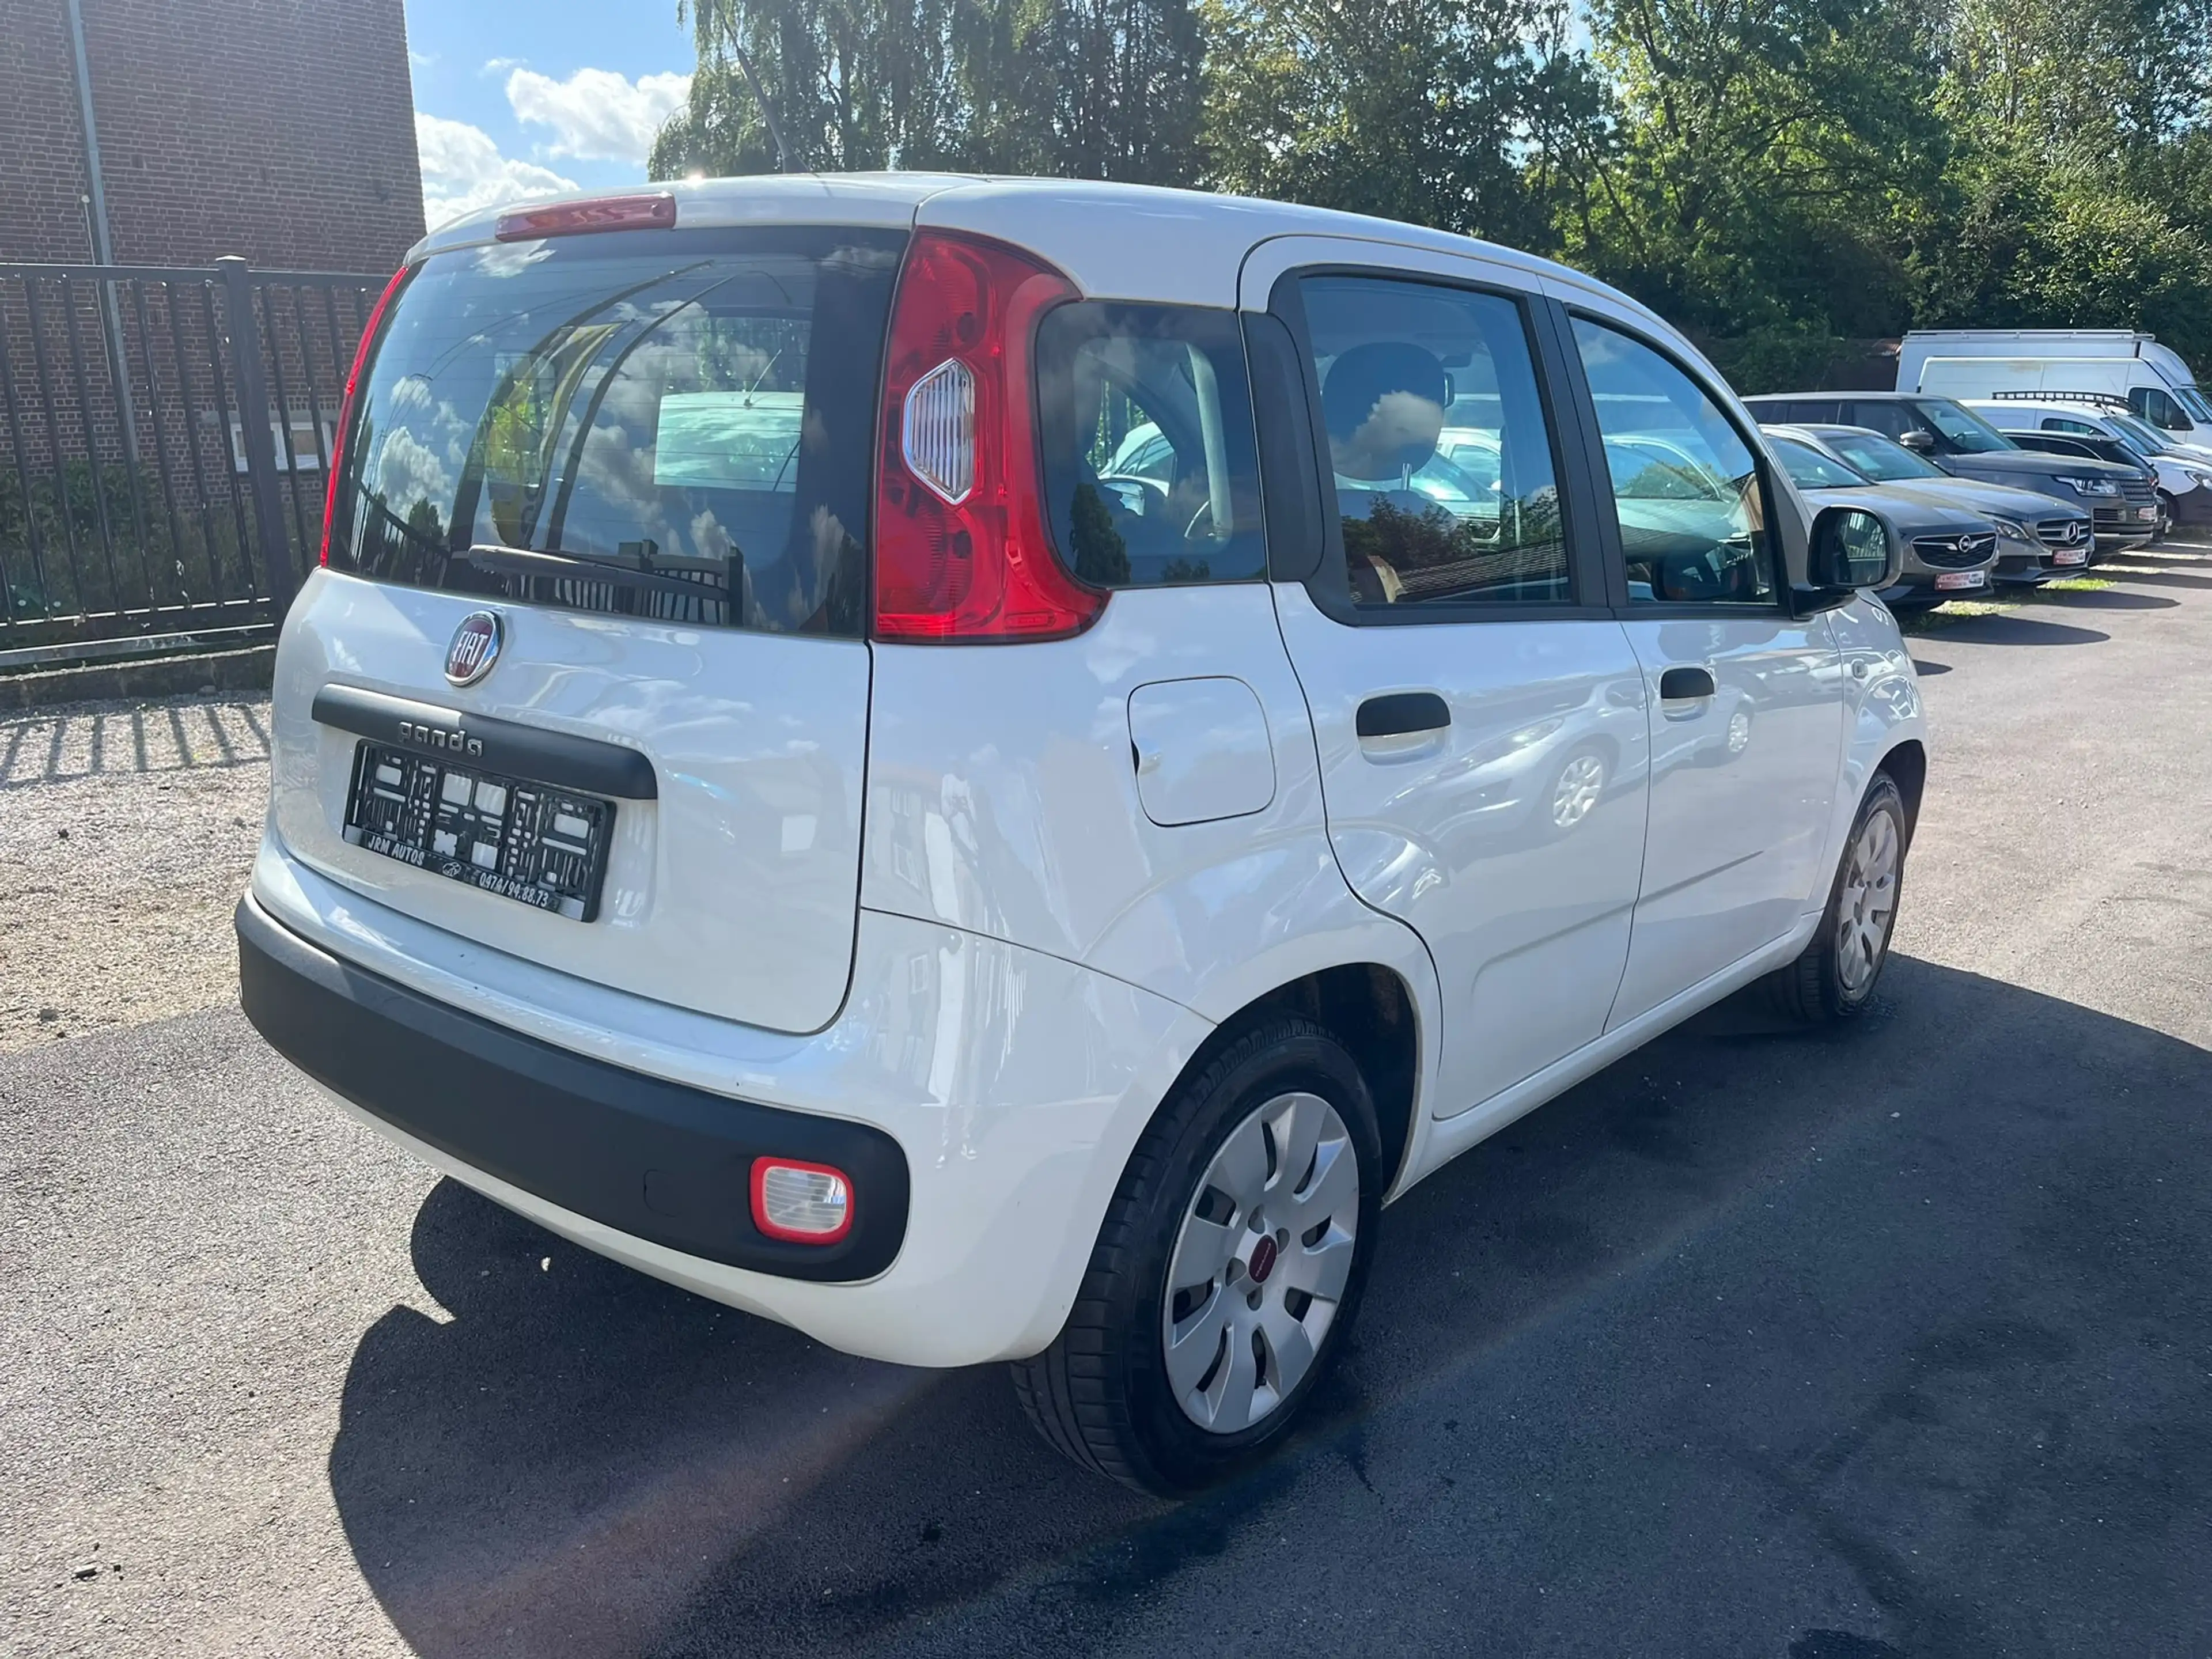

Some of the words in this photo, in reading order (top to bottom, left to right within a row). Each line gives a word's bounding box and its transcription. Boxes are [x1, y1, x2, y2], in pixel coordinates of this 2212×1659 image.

[452, 631, 488, 666] FIAT
[398, 722, 483, 757] panda
[368, 835, 391, 855] JRM
[391, 843, 425, 866] AUTOS
